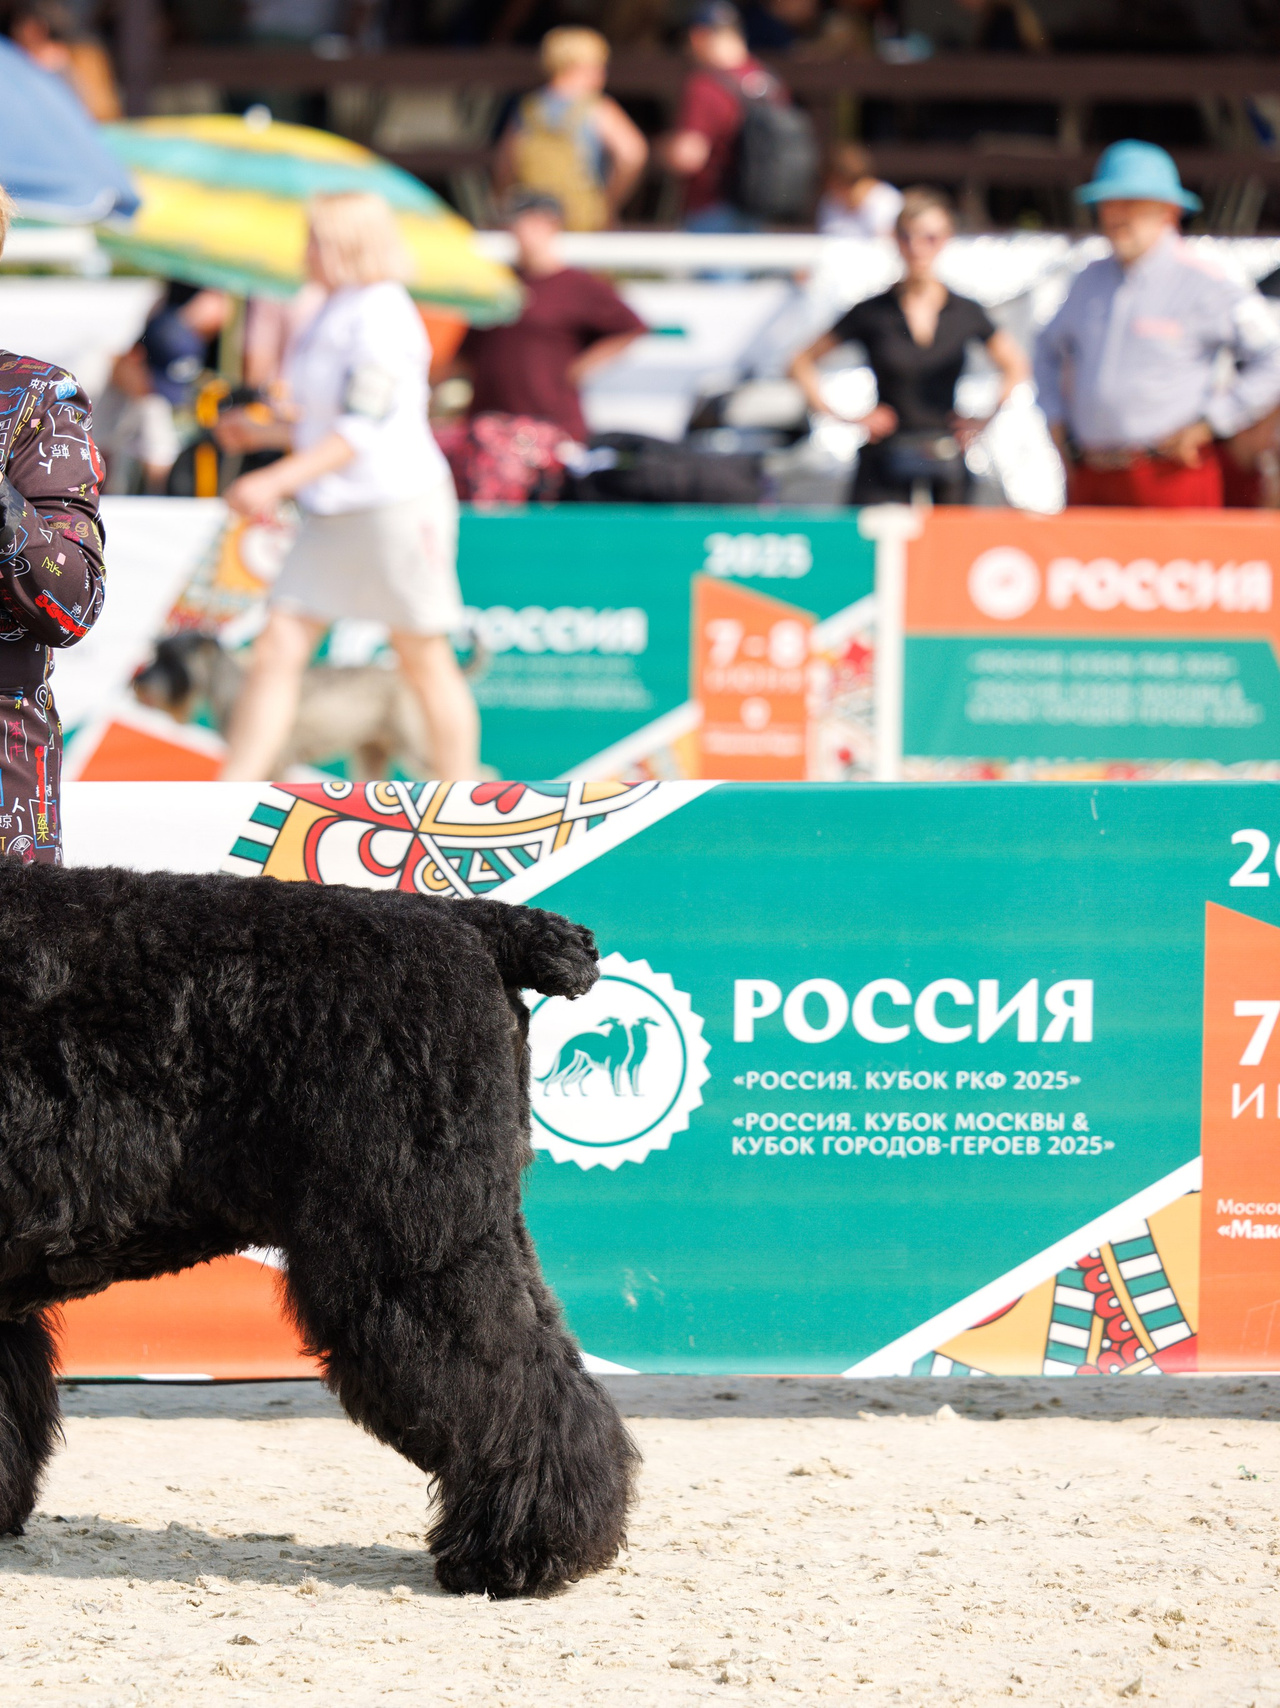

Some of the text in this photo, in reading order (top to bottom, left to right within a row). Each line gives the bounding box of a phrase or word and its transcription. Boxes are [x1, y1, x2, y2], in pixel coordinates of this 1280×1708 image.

[1230, 829, 1280, 887] 2
[733, 977, 1094, 1044] РОССИЯ
[1234, 1000, 1280, 1066] 7
[733, 1070, 1081, 1091] «РОССИЯ. КУБОК РКФ 2025»
[732, 1111, 1090, 1132] «РОССИЯ. КУБОК МОСКВЫ &
[732, 1135, 1115, 1158] КУБОК ГОРОДОВ-ГЕРОЕВ 2025»
[1216, 1198, 1280, 1216] Моско
[1217, 1218, 1280, 1239] «Мак
